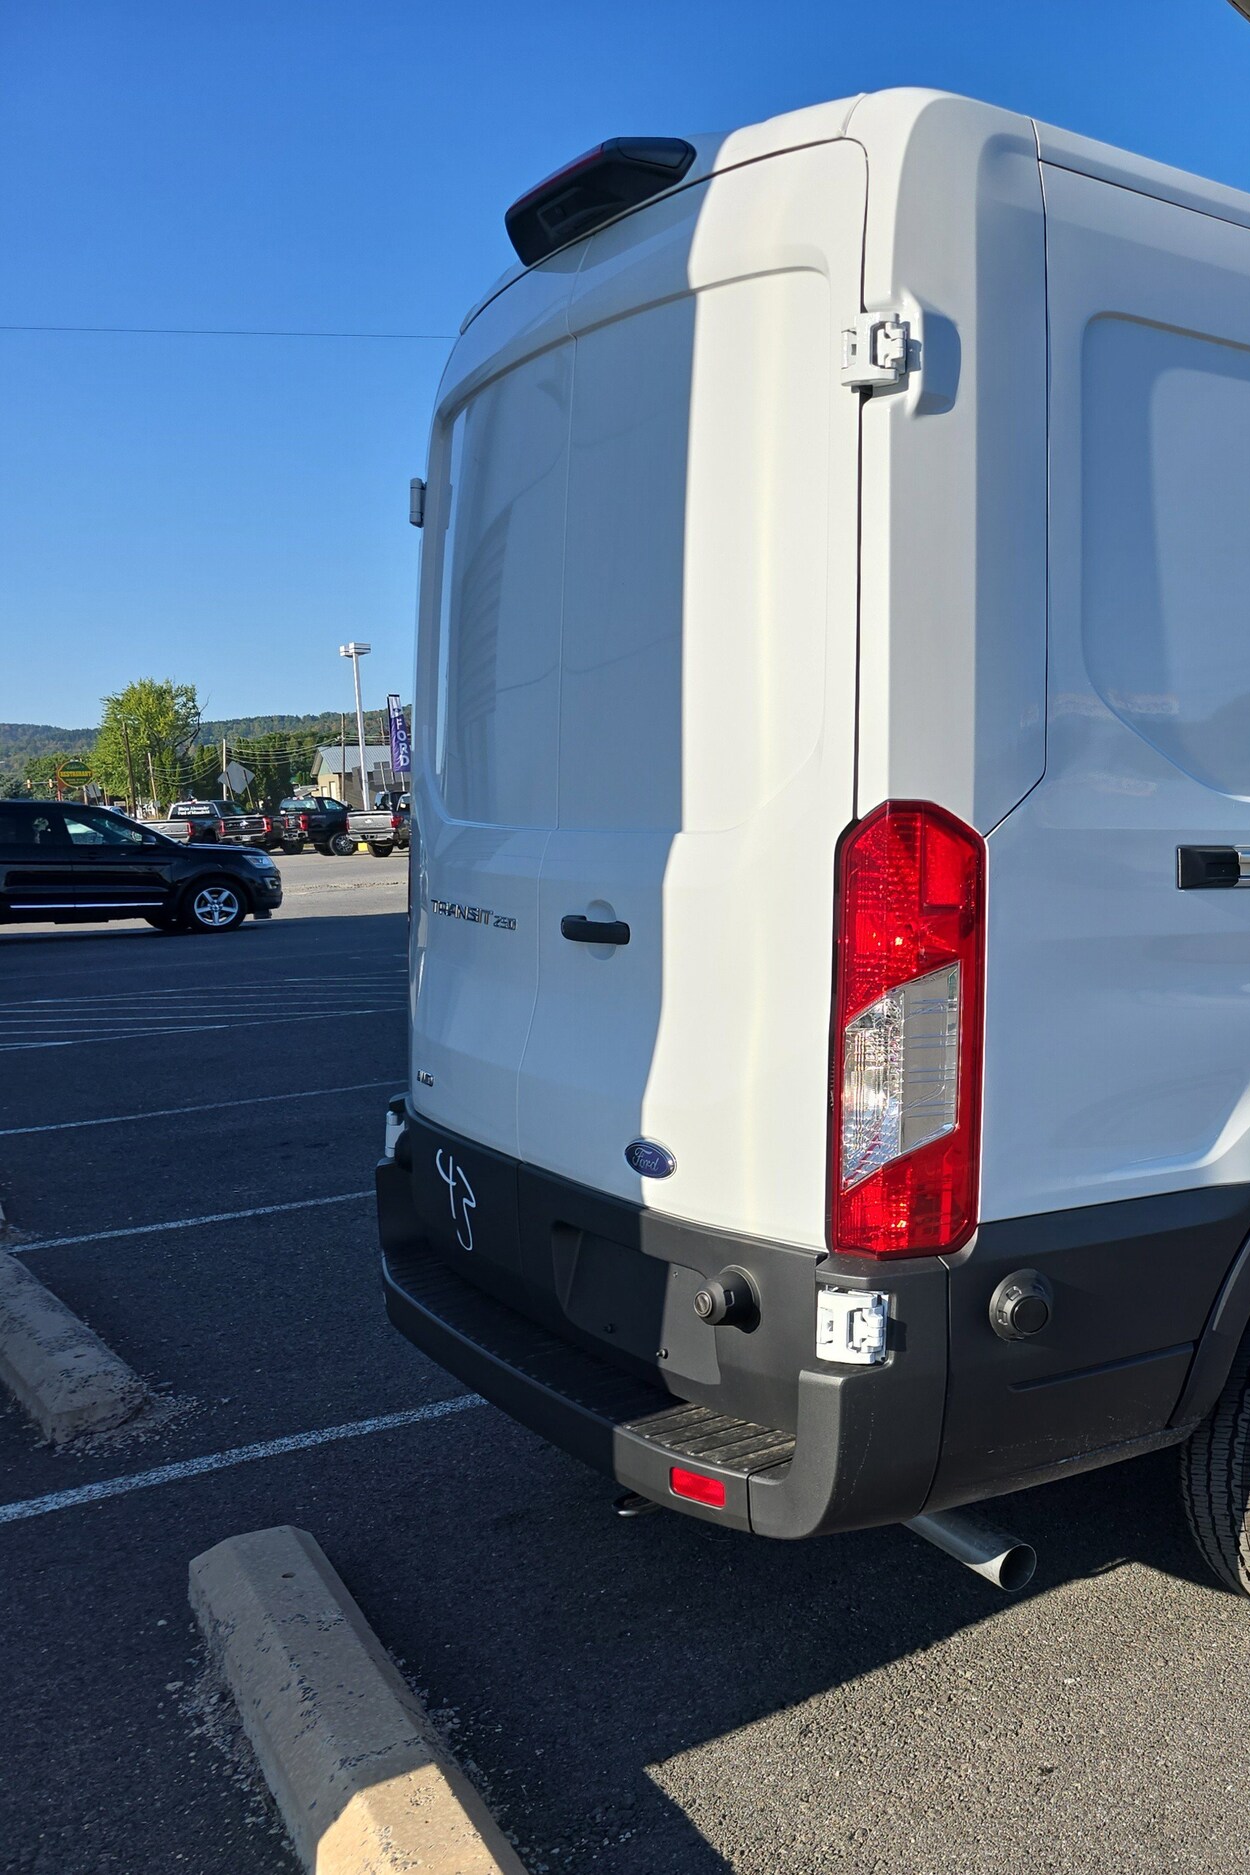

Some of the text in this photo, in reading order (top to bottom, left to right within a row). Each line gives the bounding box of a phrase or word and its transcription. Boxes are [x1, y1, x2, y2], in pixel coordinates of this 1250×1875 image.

[396, 718, 410, 767] FORD
[431, 899, 517, 930] TRANSIT 250
[632, 1147, 659, 1171] Ford
